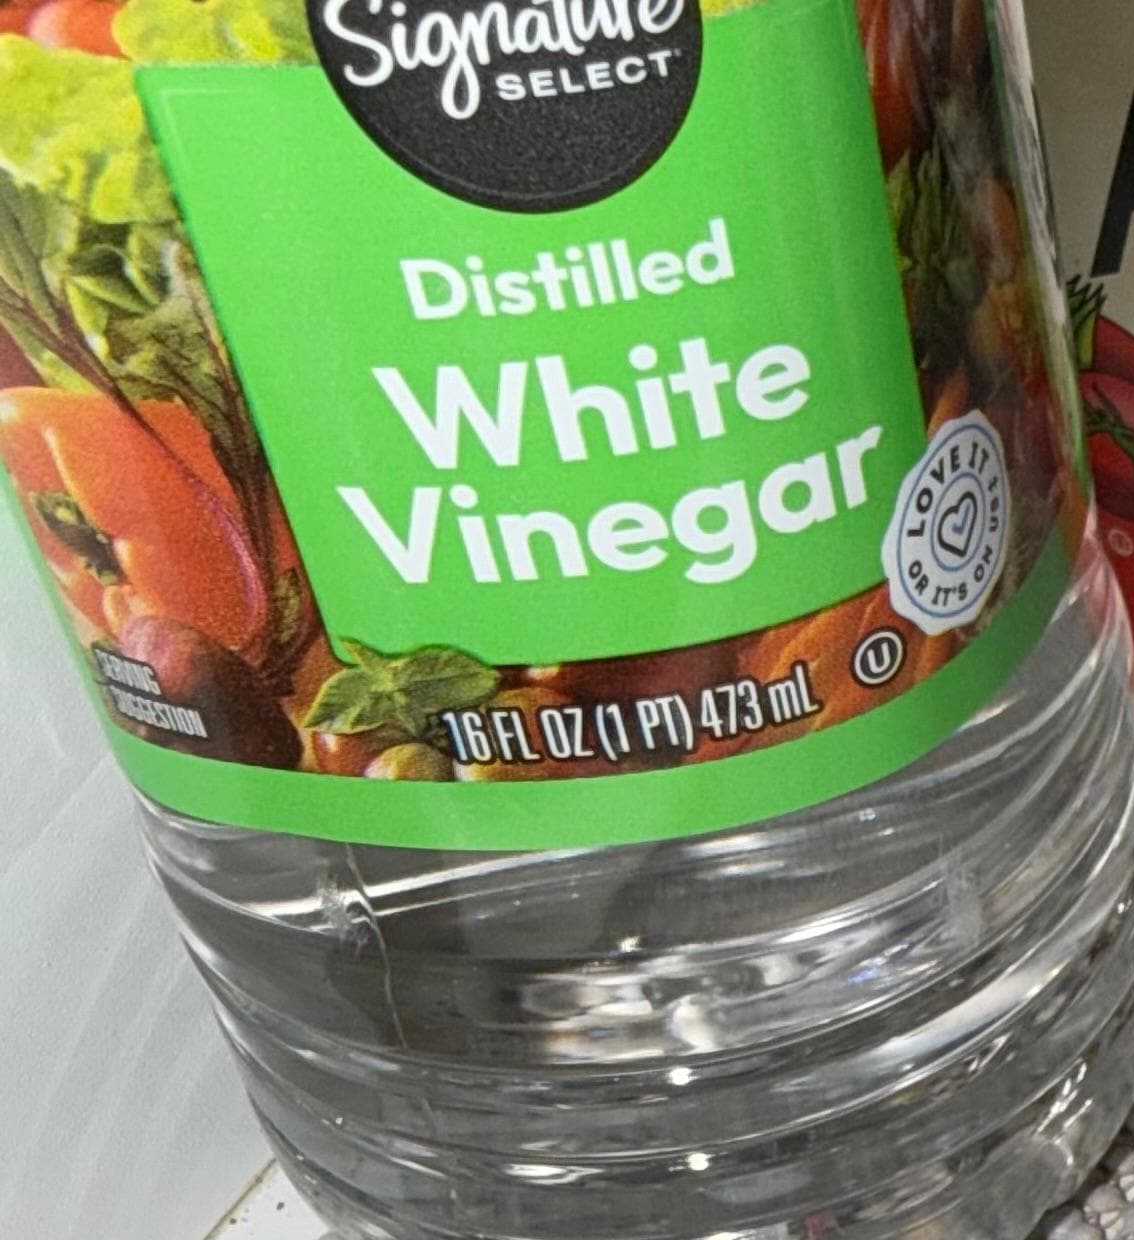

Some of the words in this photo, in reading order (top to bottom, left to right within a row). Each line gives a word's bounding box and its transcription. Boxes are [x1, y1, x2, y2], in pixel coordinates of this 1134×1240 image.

[323, 0, 685, 119] Signature
[495, 51, 672, 101] SELECT
[400, 217, 735, 321] Distilled
[371, 337, 812, 470] White
[335, 425, 882, 584] Vinegar
[907, 445, 961, 537] LOVE
[968, 442, 990, 475] IT
[908, 560, 929, 596] OR
[931, 581, 968, 606] IT'S
[974, 545, 993, 582] ON
[443, 710, 492, 762] 16
[490, 707, 540, 761] FL
[543, 706, 596, 759] OZ
[595, 704, 631, 762] (1
[634, 695, 694, 751] PT)
[700, 679, 763, 738] 473
[768, 664, 820, 724] mL
